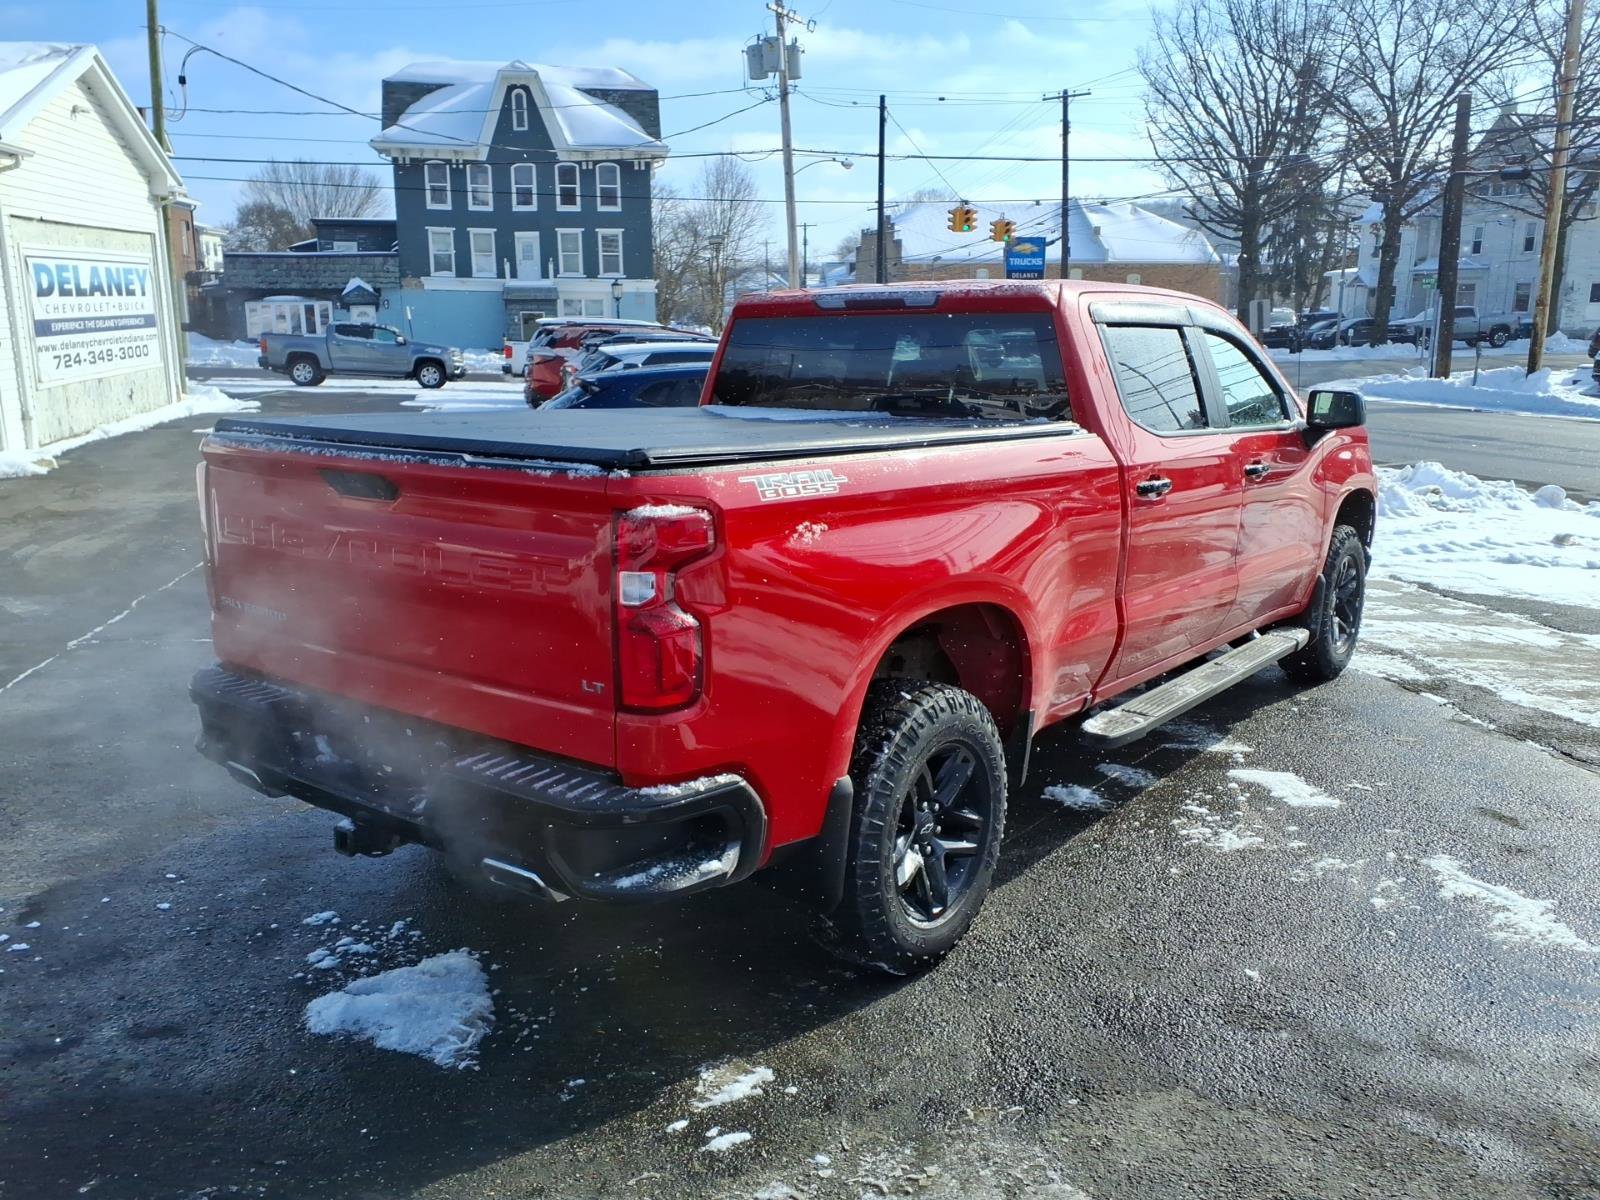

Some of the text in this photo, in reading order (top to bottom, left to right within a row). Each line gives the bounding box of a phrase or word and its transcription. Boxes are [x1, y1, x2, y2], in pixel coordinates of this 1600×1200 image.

[1009, 258, 1043, 266] TRUCKS
[33, 263, 148, 297] DELANEY
[45, 301, 145, 314] CHEVROLET BUICK
[51, 317, 145, 331] EXPERIENCE THE DELANEY DIFFERENCE
[738, 469, 848, 489] TRAIL
[760, 482, 840, 501] BOSS
[581, 679, 605, 695] LT
